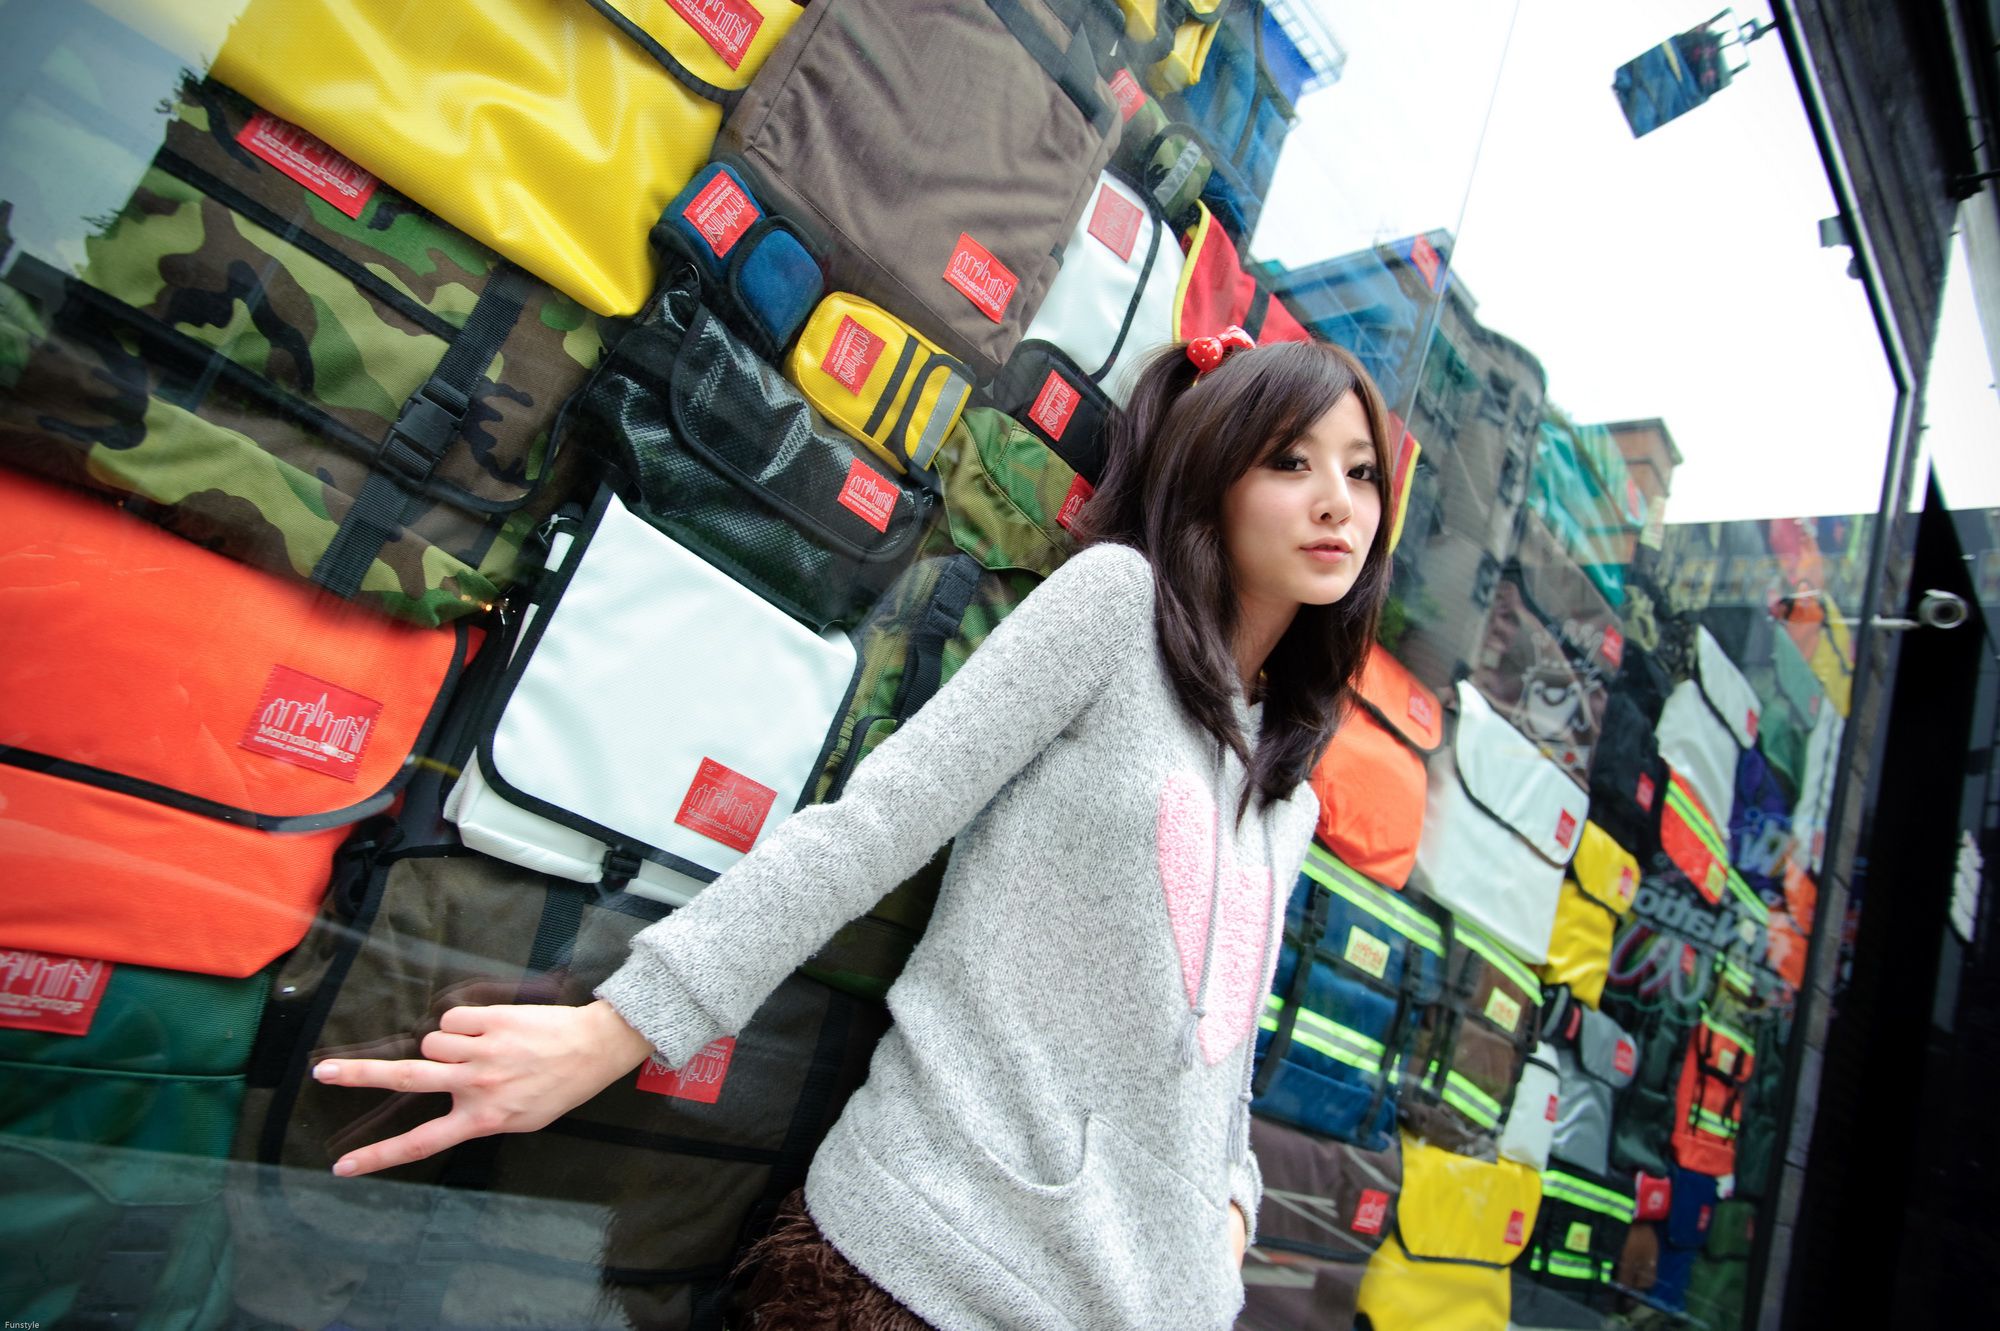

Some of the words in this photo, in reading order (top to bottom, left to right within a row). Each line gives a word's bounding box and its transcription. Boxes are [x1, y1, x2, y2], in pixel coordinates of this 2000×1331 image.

[713, 25, 738, 53] Portage
[255, 130, 320, 175] Manhattan
[317, 165, 358, 198] Portage
[258, 724, 320, 752] Manhattan
